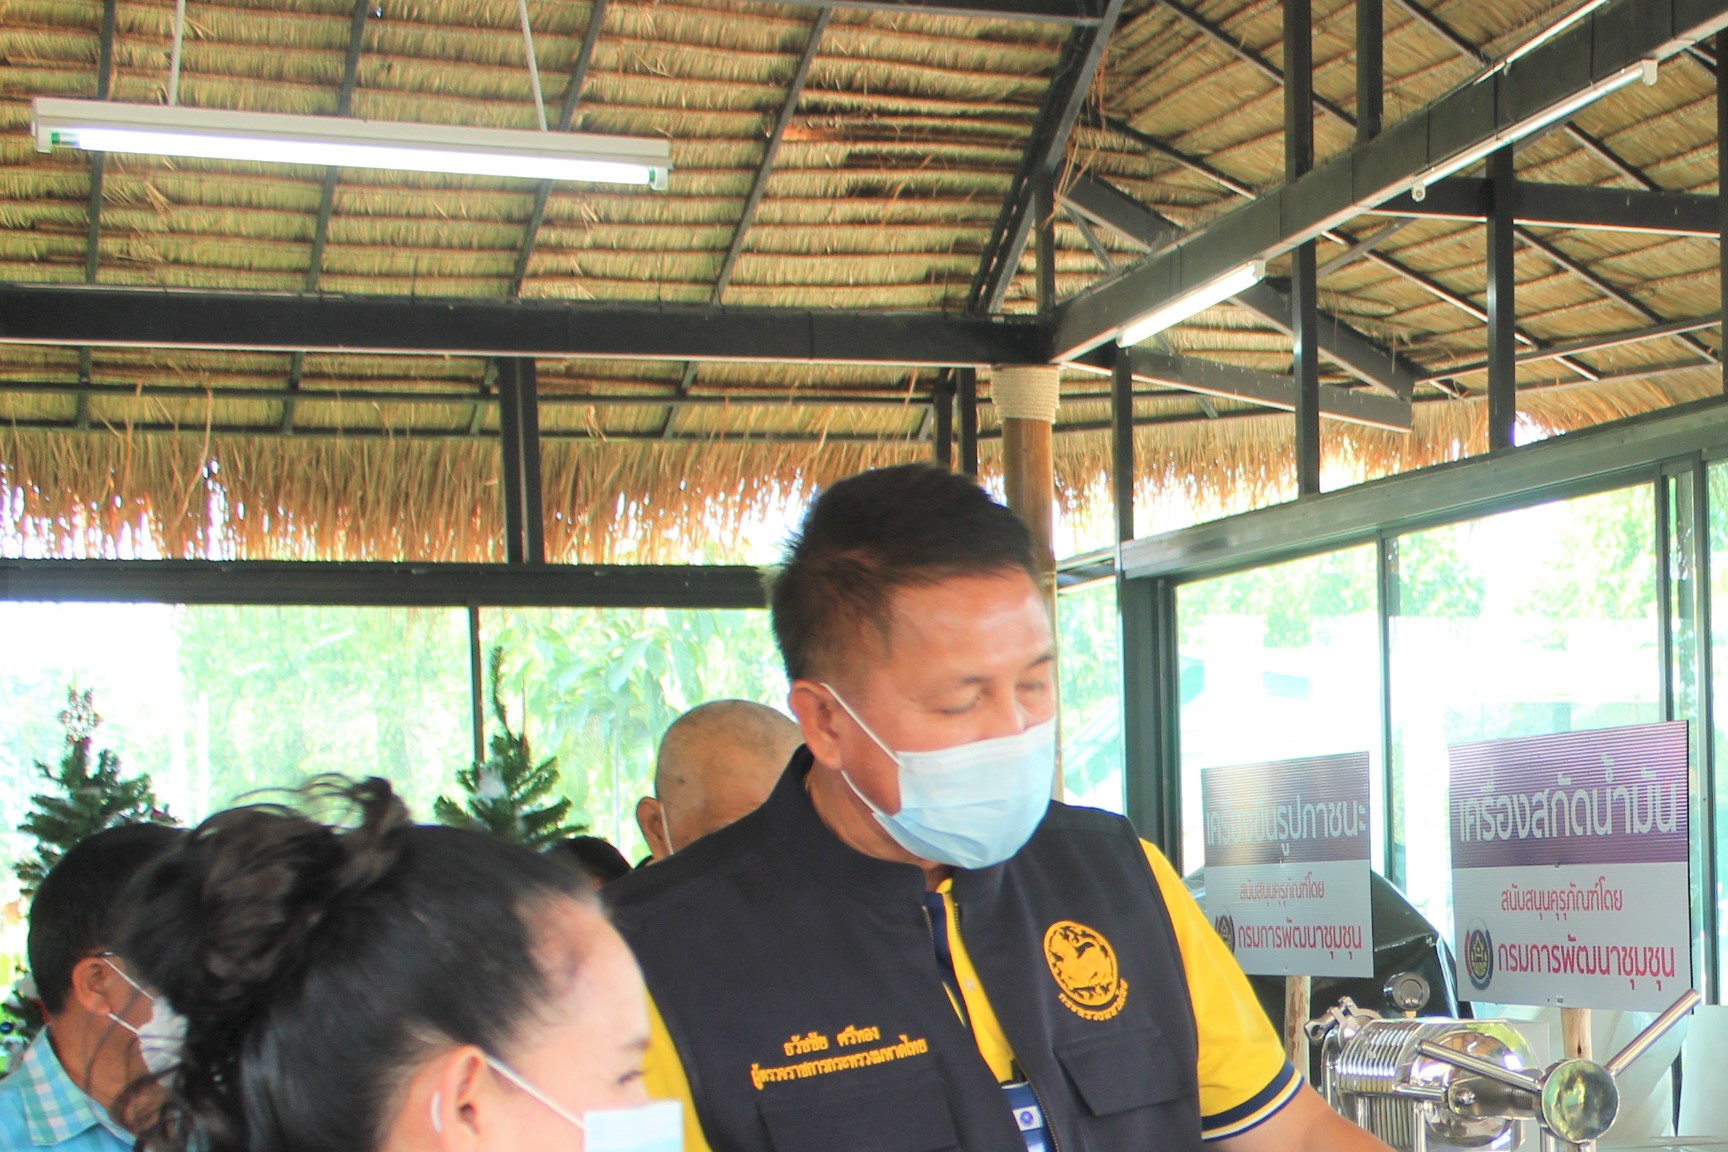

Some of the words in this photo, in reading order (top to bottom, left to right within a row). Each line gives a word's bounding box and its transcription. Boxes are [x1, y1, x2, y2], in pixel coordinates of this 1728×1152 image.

[1459, 753, 1678, 843] เครื่องสกัดน้ำมัน
